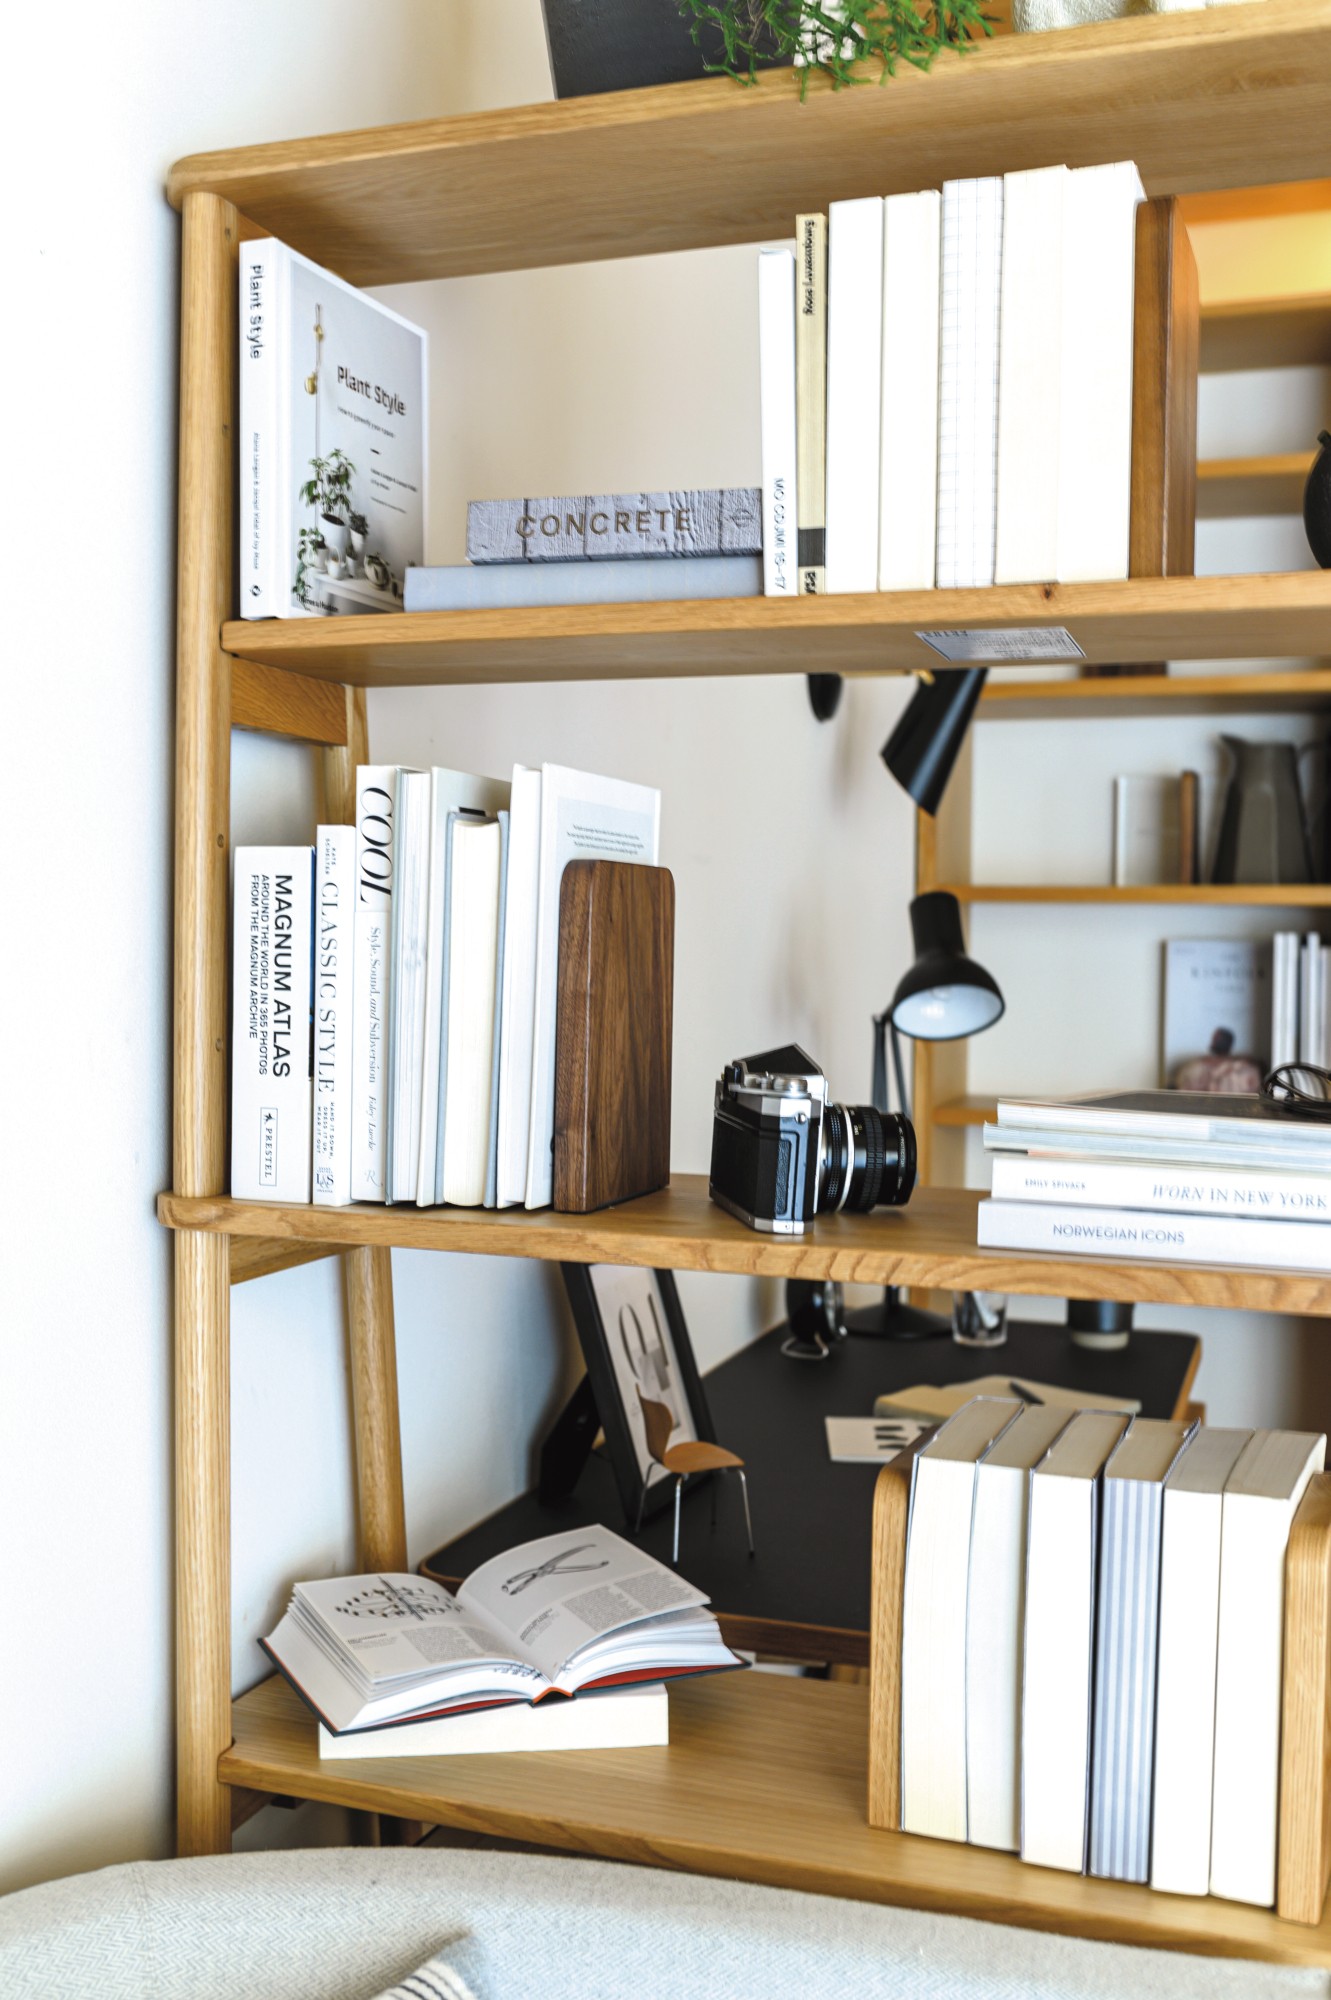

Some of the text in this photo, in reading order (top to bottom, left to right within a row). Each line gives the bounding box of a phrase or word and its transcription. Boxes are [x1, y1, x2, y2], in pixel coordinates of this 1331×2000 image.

[246, 264, 265, 360] Plant Style
[337, 365, 406, 416] Plant Style
[515, 508, 691, 539] CONCRETE
[359, 786, 394, 904] COOL
[249, 874, 260, 1039] FROM THE MAGNUM ARCHIVE
[258, 874, 270, 1075] AROUND THE WORLD IN 365 PHOTOS
[272, 874, 293, 1078] MAGNUM ATLAS
[318, 881, 339, 1093] CLASSIC STYLE
[369, 998, 381, 1021] and
[368, 1021, 381, 1083] Subversion
[264, 1127, 273, 1179] PRESTEL
[1024, 1178, 1087, 1191] EMILY SPIVACK
[1152, 1184, 1328, 1209] WORN IN NEW YORK
[1052, 1223, 1185, 1244] NORWEGIAN ICONS
